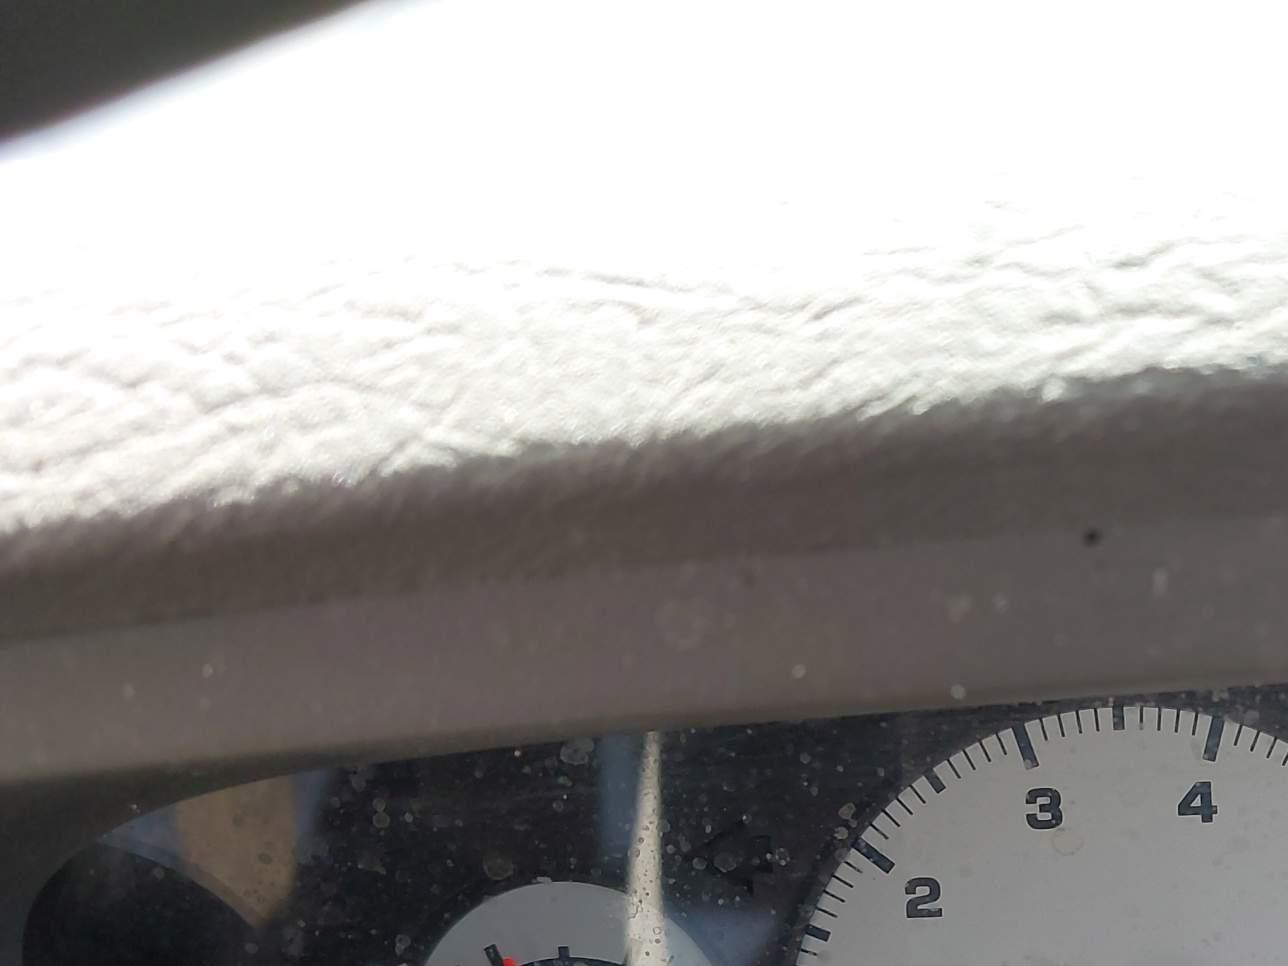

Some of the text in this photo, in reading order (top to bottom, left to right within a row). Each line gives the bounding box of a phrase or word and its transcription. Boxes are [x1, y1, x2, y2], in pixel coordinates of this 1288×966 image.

[1026, 788, 1063, 829] 3
[1177, 781, 1218, 822] 4
[905, 877, 943, 918] 2
